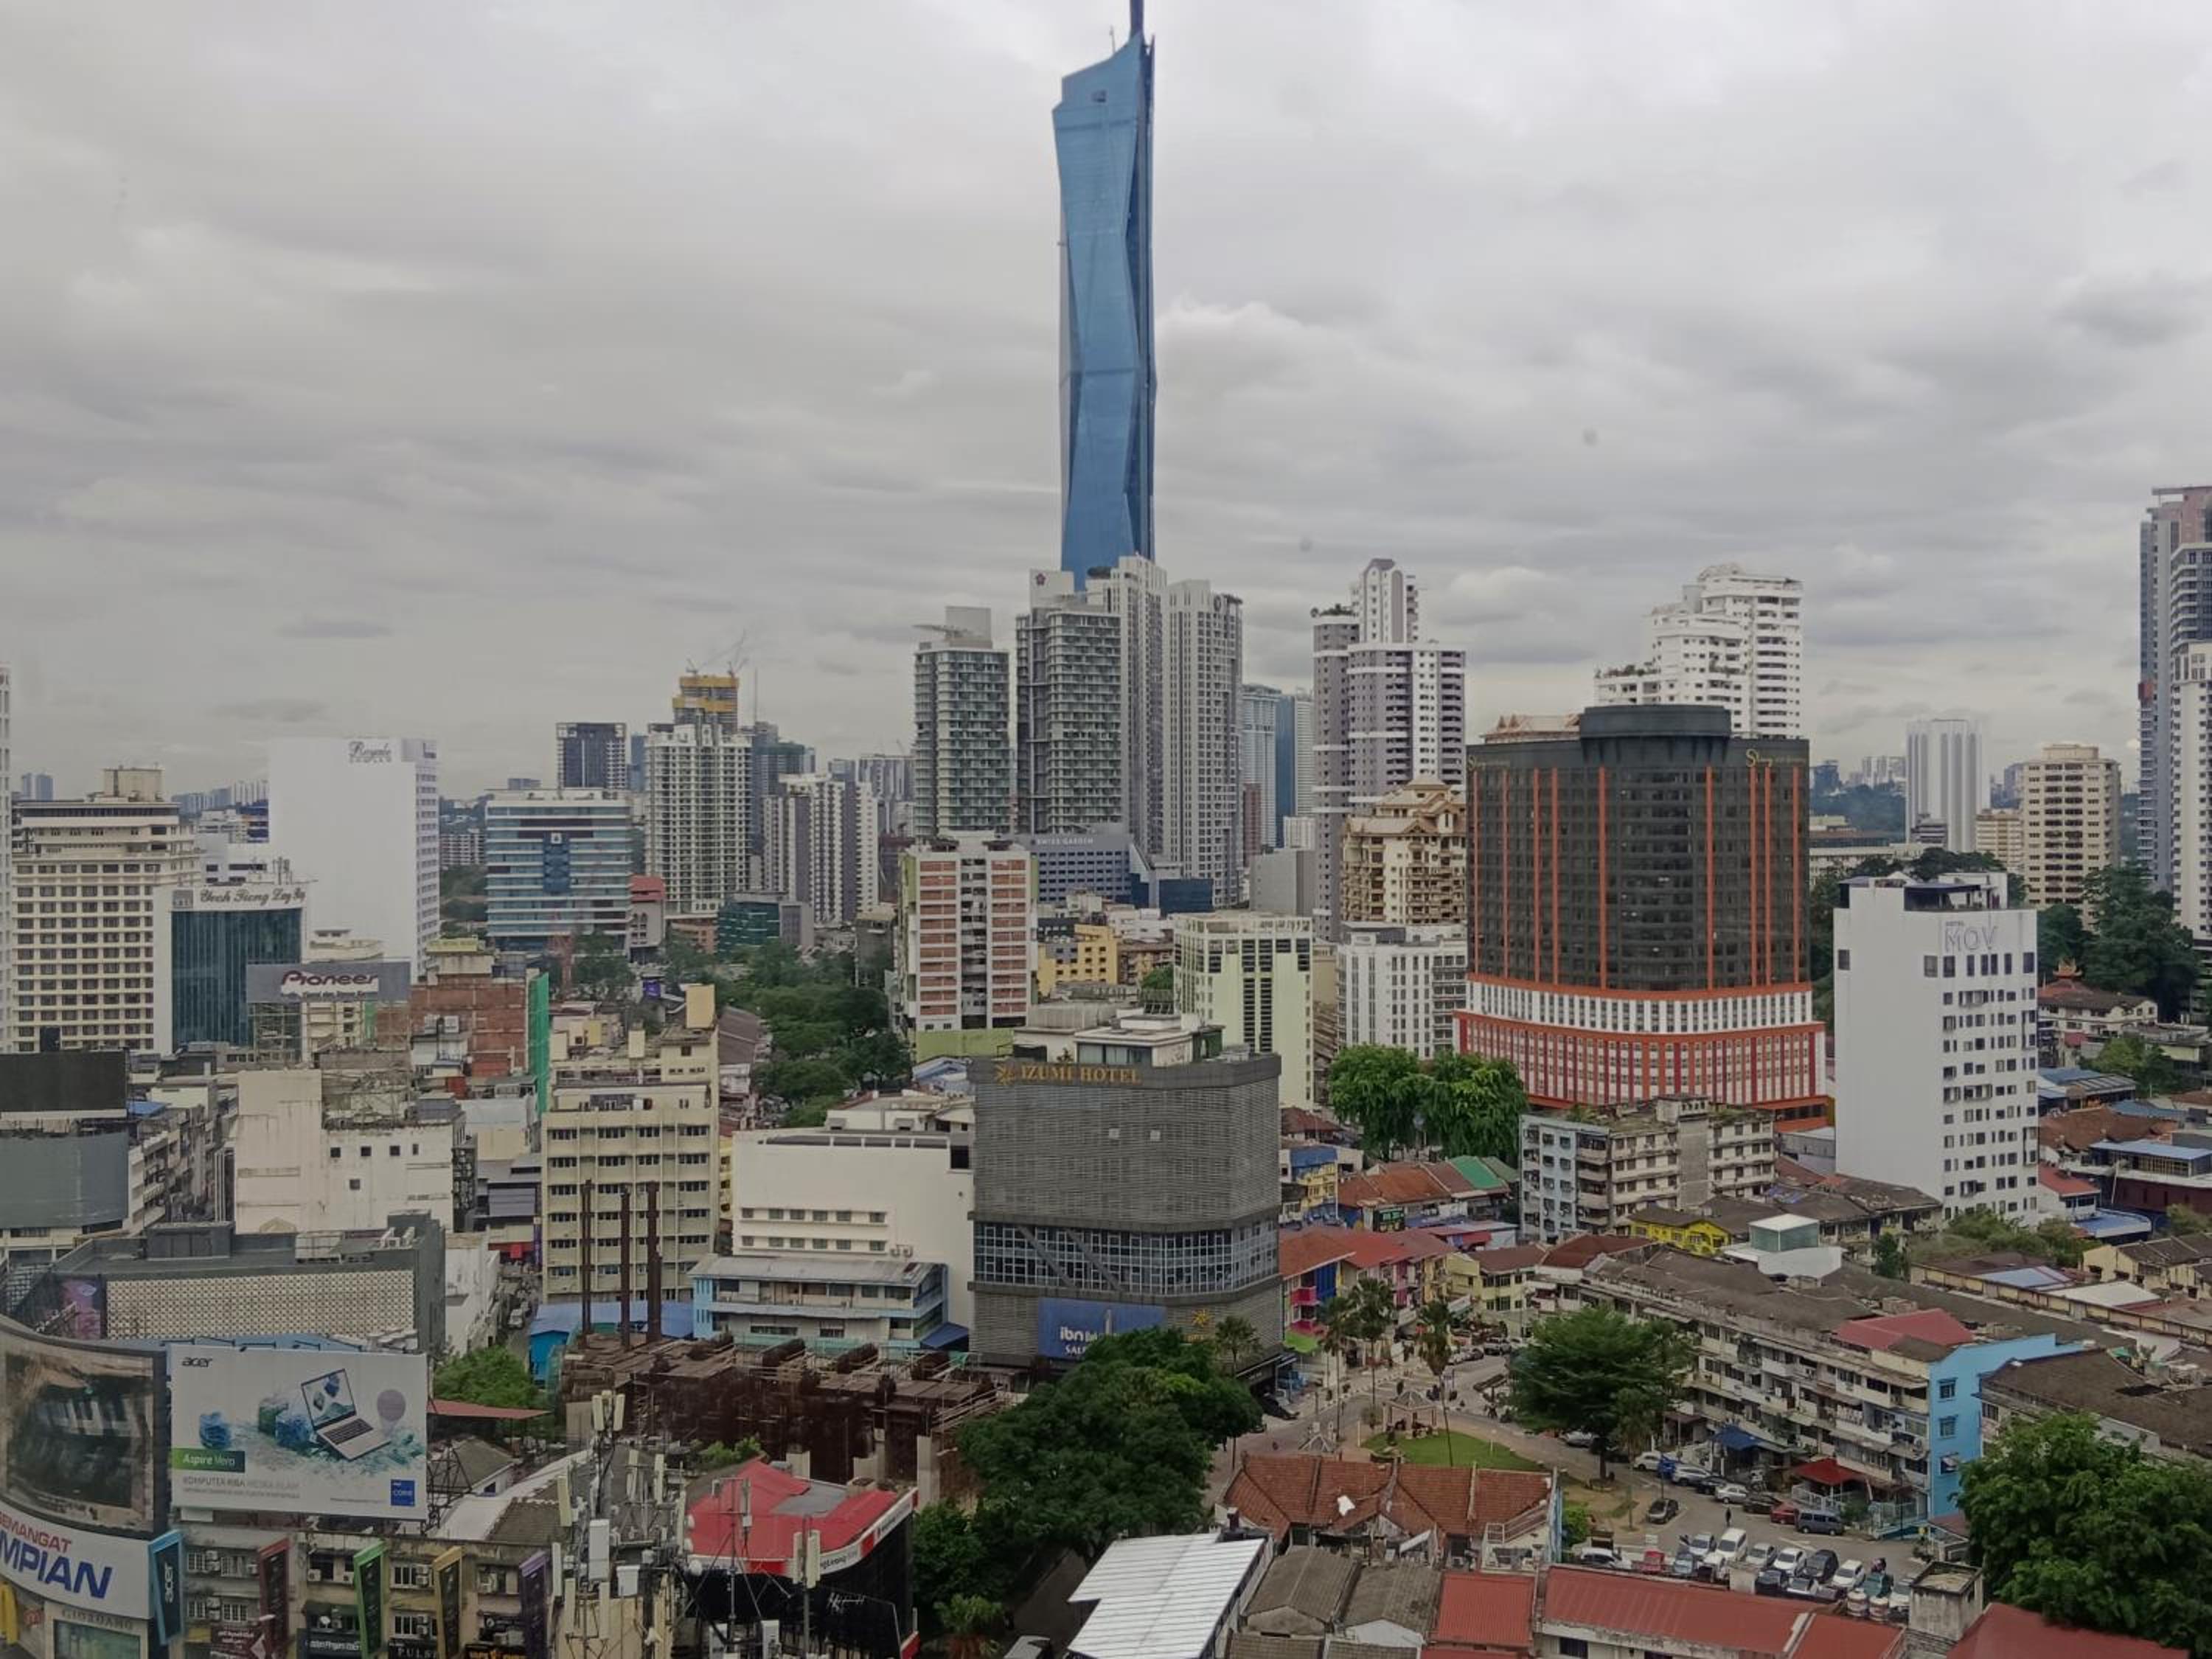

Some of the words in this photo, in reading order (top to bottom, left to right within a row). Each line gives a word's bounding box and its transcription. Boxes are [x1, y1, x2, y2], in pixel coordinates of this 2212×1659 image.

[282, 970, 378, 986] Pioneer
[1021, 1065, 1074, 1081] IZUMI
[1080, 1067, 1141, 1083] HOTEL
[182, 1357, 213, 1368] acer
[183, 1454, 213, 1466] Aspire
[0, 1512, 72, 1554] EMANGAT
[164, 1562, 174, 1603] acer
